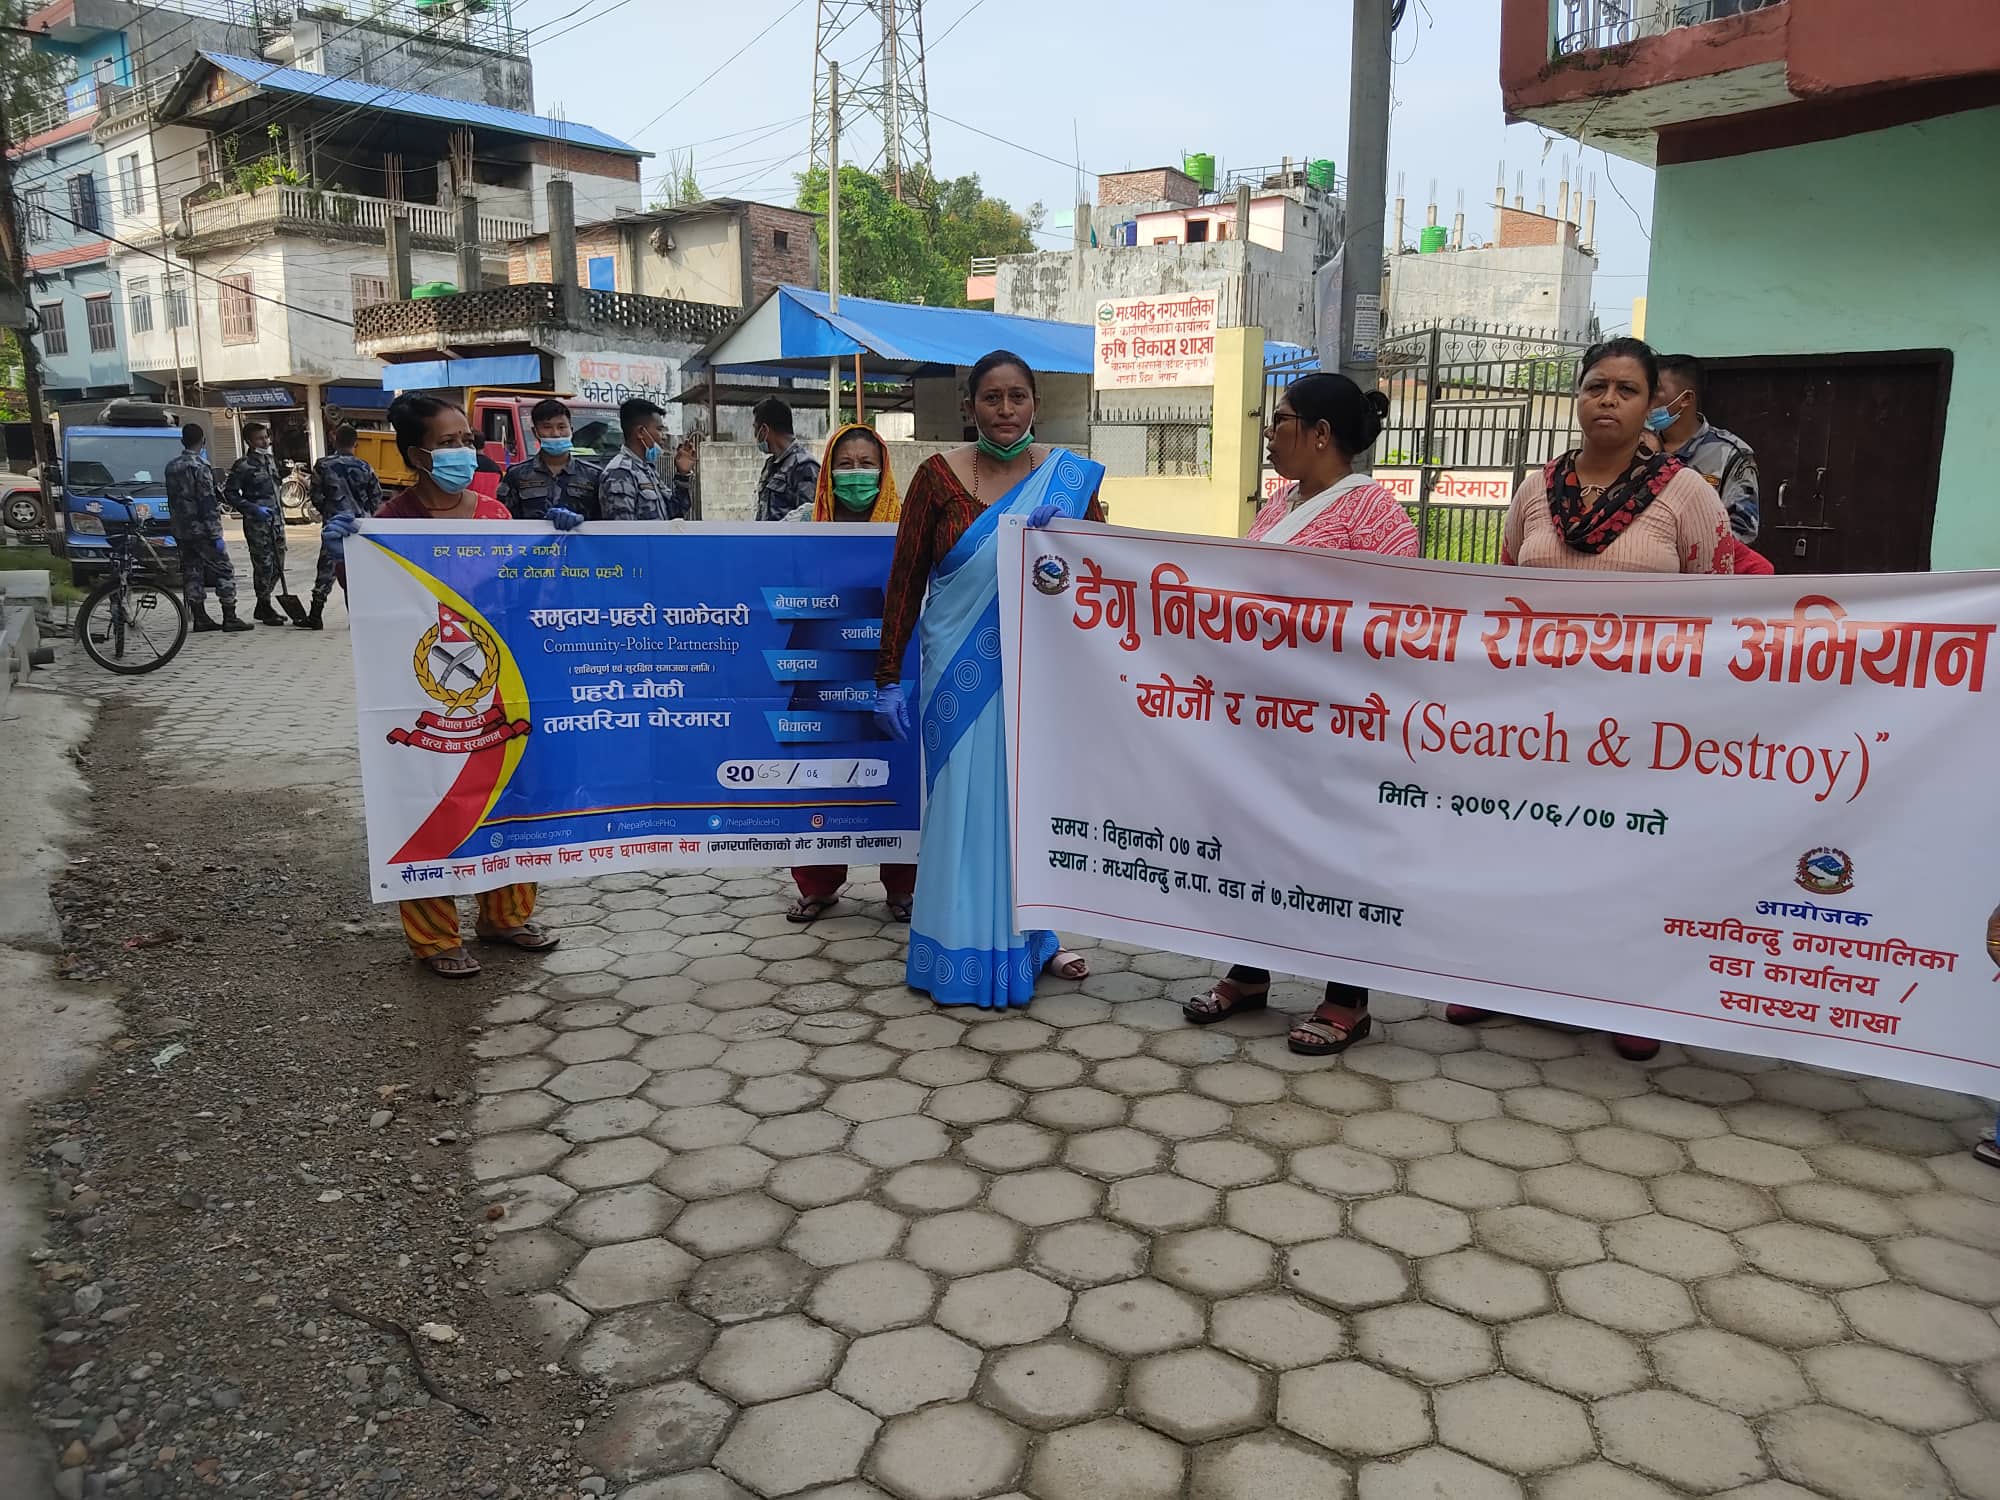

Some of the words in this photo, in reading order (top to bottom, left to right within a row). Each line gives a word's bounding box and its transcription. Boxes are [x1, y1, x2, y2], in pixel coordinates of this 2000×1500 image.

[1157, 296, 1214, 318] नगरपालिका
[1101, 338, 1127, 364] कृषि
[1132, 337, 1176, 358] विकास
[1180, 336, 1214, 355] शाखा
[583, 382, 613, 404] फोटो
[1435, 474, 1507, 498] चोरमारा
[498, 565, 518, 578] टोल
[523, 564, 556, 578] टोलमा
[560, 564, 590, 578] नेपाल
[595, 564, 624, 580] प्रहरी
[776, 594, 808, 608] नेपाल
[812, 595, 840, 610] प्रहरी
[529, 602, 657, 631] समुदाय-प्रहरी
[663, 602, 750, 626] साझेदारी
[1073, 557, 1141, 652] डेंगु
[1150, 562, 1353, 654] नियन्त्रण
[1363, 601, 1468, 663] तथा
[1480, 596, 1713, 678] रोकथाम
[1727, 594, 1998, 693] अभियान
[543, 636, 664, 655] Community-Police
[667, 636, 740, 656] Partnership
[776, 658, 818, 673] समुदाय
[571, 679, 626, 704] प्रहरी
[632, 678, 686, 699] चौकी
[818, 688, 870, 702] सामाजिक
[436, 718, 462, 729] नेपाल
[464, 715, 487, 729] प्रहरी
[544, 708, 641, 734] तमसरिया
[648, 706, 732, 728] चोरमारा
[778, 718, 822, 733] विद्यालय
[1224, 692, 1246, 726] र
[1255, 694, 1320, 734] नष्ट
[1330, 692, 1391, 742] गरौ
[1402, 699, 1571, 764] (Search
[1586, 716, 1632, 768] &
[420, 735, 442, 750] सत्य
[444, 740, 461, 751] सेवा
[1378, 780, 1429, 809] मिति
[1450, 792, 1616, 830] २०७९/०६/०७
[1626, 808, 1668, 836] गते
[1050, 816, 1090, 840] समय
[1102, 819, 1164, 852] विहानको
[1169, 836, 1190, 856] ०७
[1196, 836, 1222, 862] बजे
[482, 855, 510, 875] विविध
[514, 852, 552, 868] फ्लेक्स
[558, 848, 584, 864] प्रिन्ट
[588, 846, 615, 863] एण्ड
[620, 841, 673, 858] छापाखाना
[679, 838, 700, 854] सेवा
[816, 834, 852, 850] अगाडी
[1048, 848, 1088, 873] स्थान
[1102, 857, 1170, 894] मध्यविन्दु
[1174, 870, 1212, 894] न.पा.
[1218, 876, 1246, 900] वडा
[1251, 879, 1266, 904] नं
[1358, 901, 1404, 927] बजार
[1755, 900, 1873, 928] आयोजक
[1663, 918, 1784, 956] मध्यविन्दु
[1792, 938, 1959, 973] नगरपालिका
[1708, 954, 1755, 978] वडा
[1764, 962, 1880, 997] कार्यालय
[1719, 989, 1820, 1023] स्वास्थ्य
[1829, 1006, 1902, 1036] शाखा
